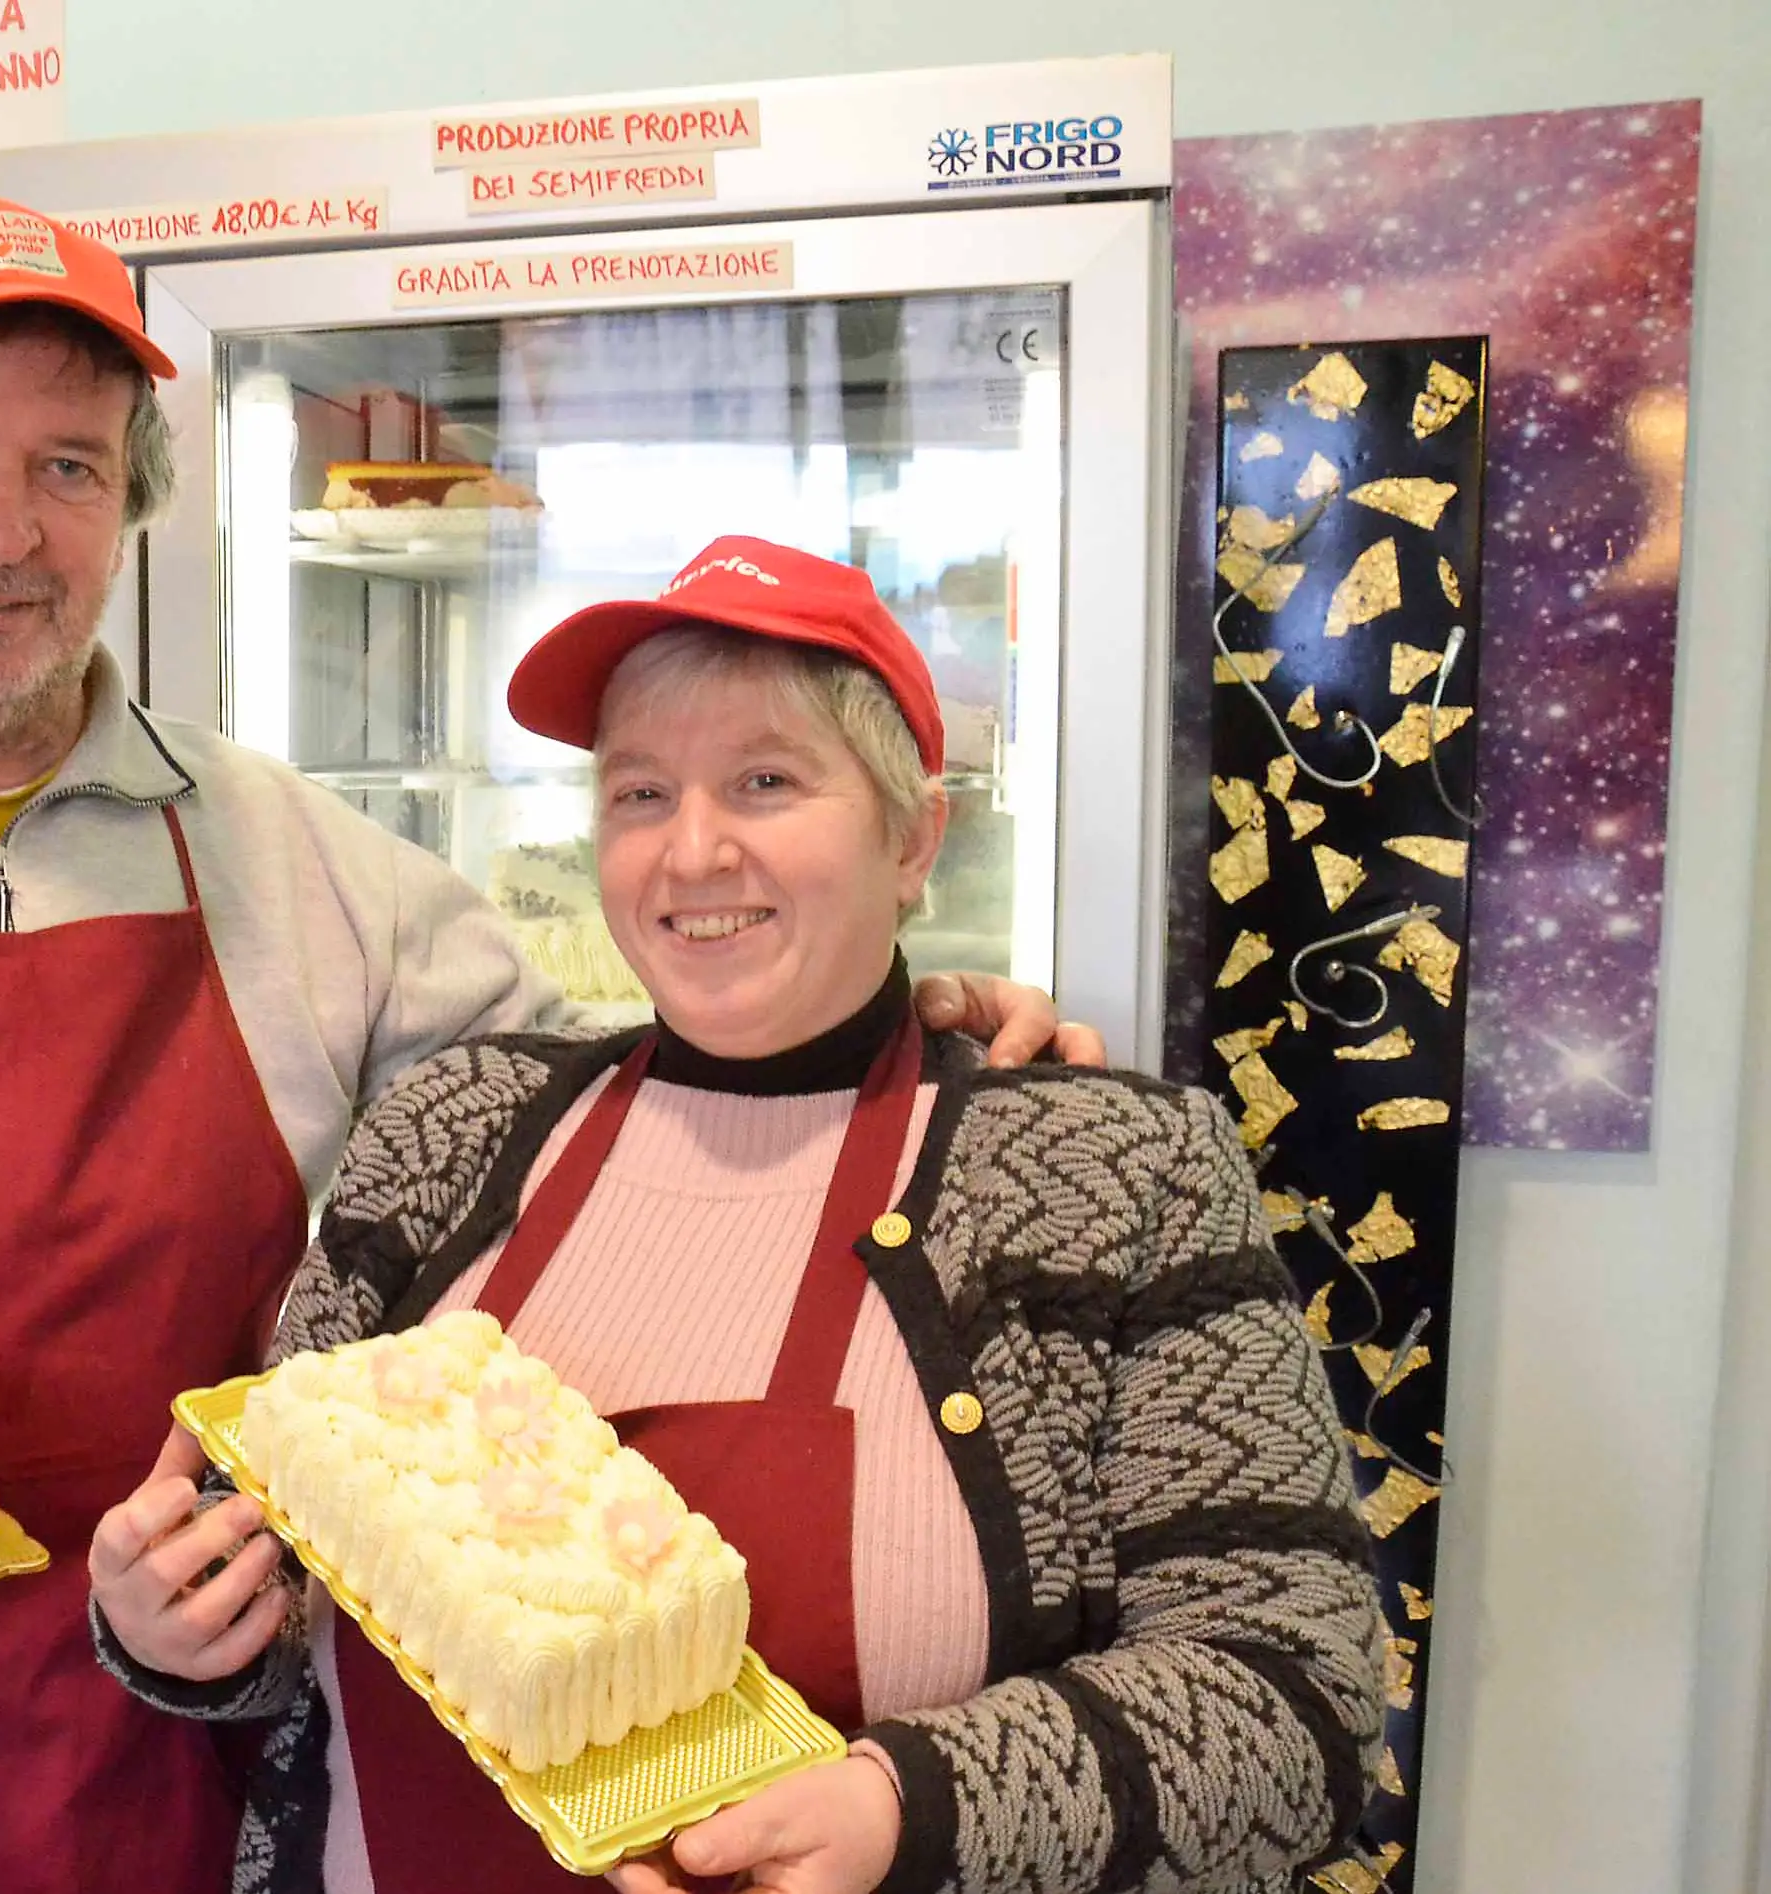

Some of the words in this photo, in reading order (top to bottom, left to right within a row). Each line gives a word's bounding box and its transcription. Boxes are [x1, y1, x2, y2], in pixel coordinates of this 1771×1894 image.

[436, 115, 615, 153] PRODUZIONE
[624, 107, 749, 144] PROPRIA
[985, 115, 1123, 147] FRIGO
[985, 142, 1122, 174] NORD
[472, 173, 515, 201] DEI
[529, 166, 705, 199] SEMIFREDDI
[66, 212, 202, 244] OMOZIONE
[306, 199, 340, 227] AL
[346, 199, 379, 231] Kg
[397, 260, 511, 295] GRADITA
[527, 260, 558, 287] LA
[571, 249, 779, 285] PRENOTAZIONE
